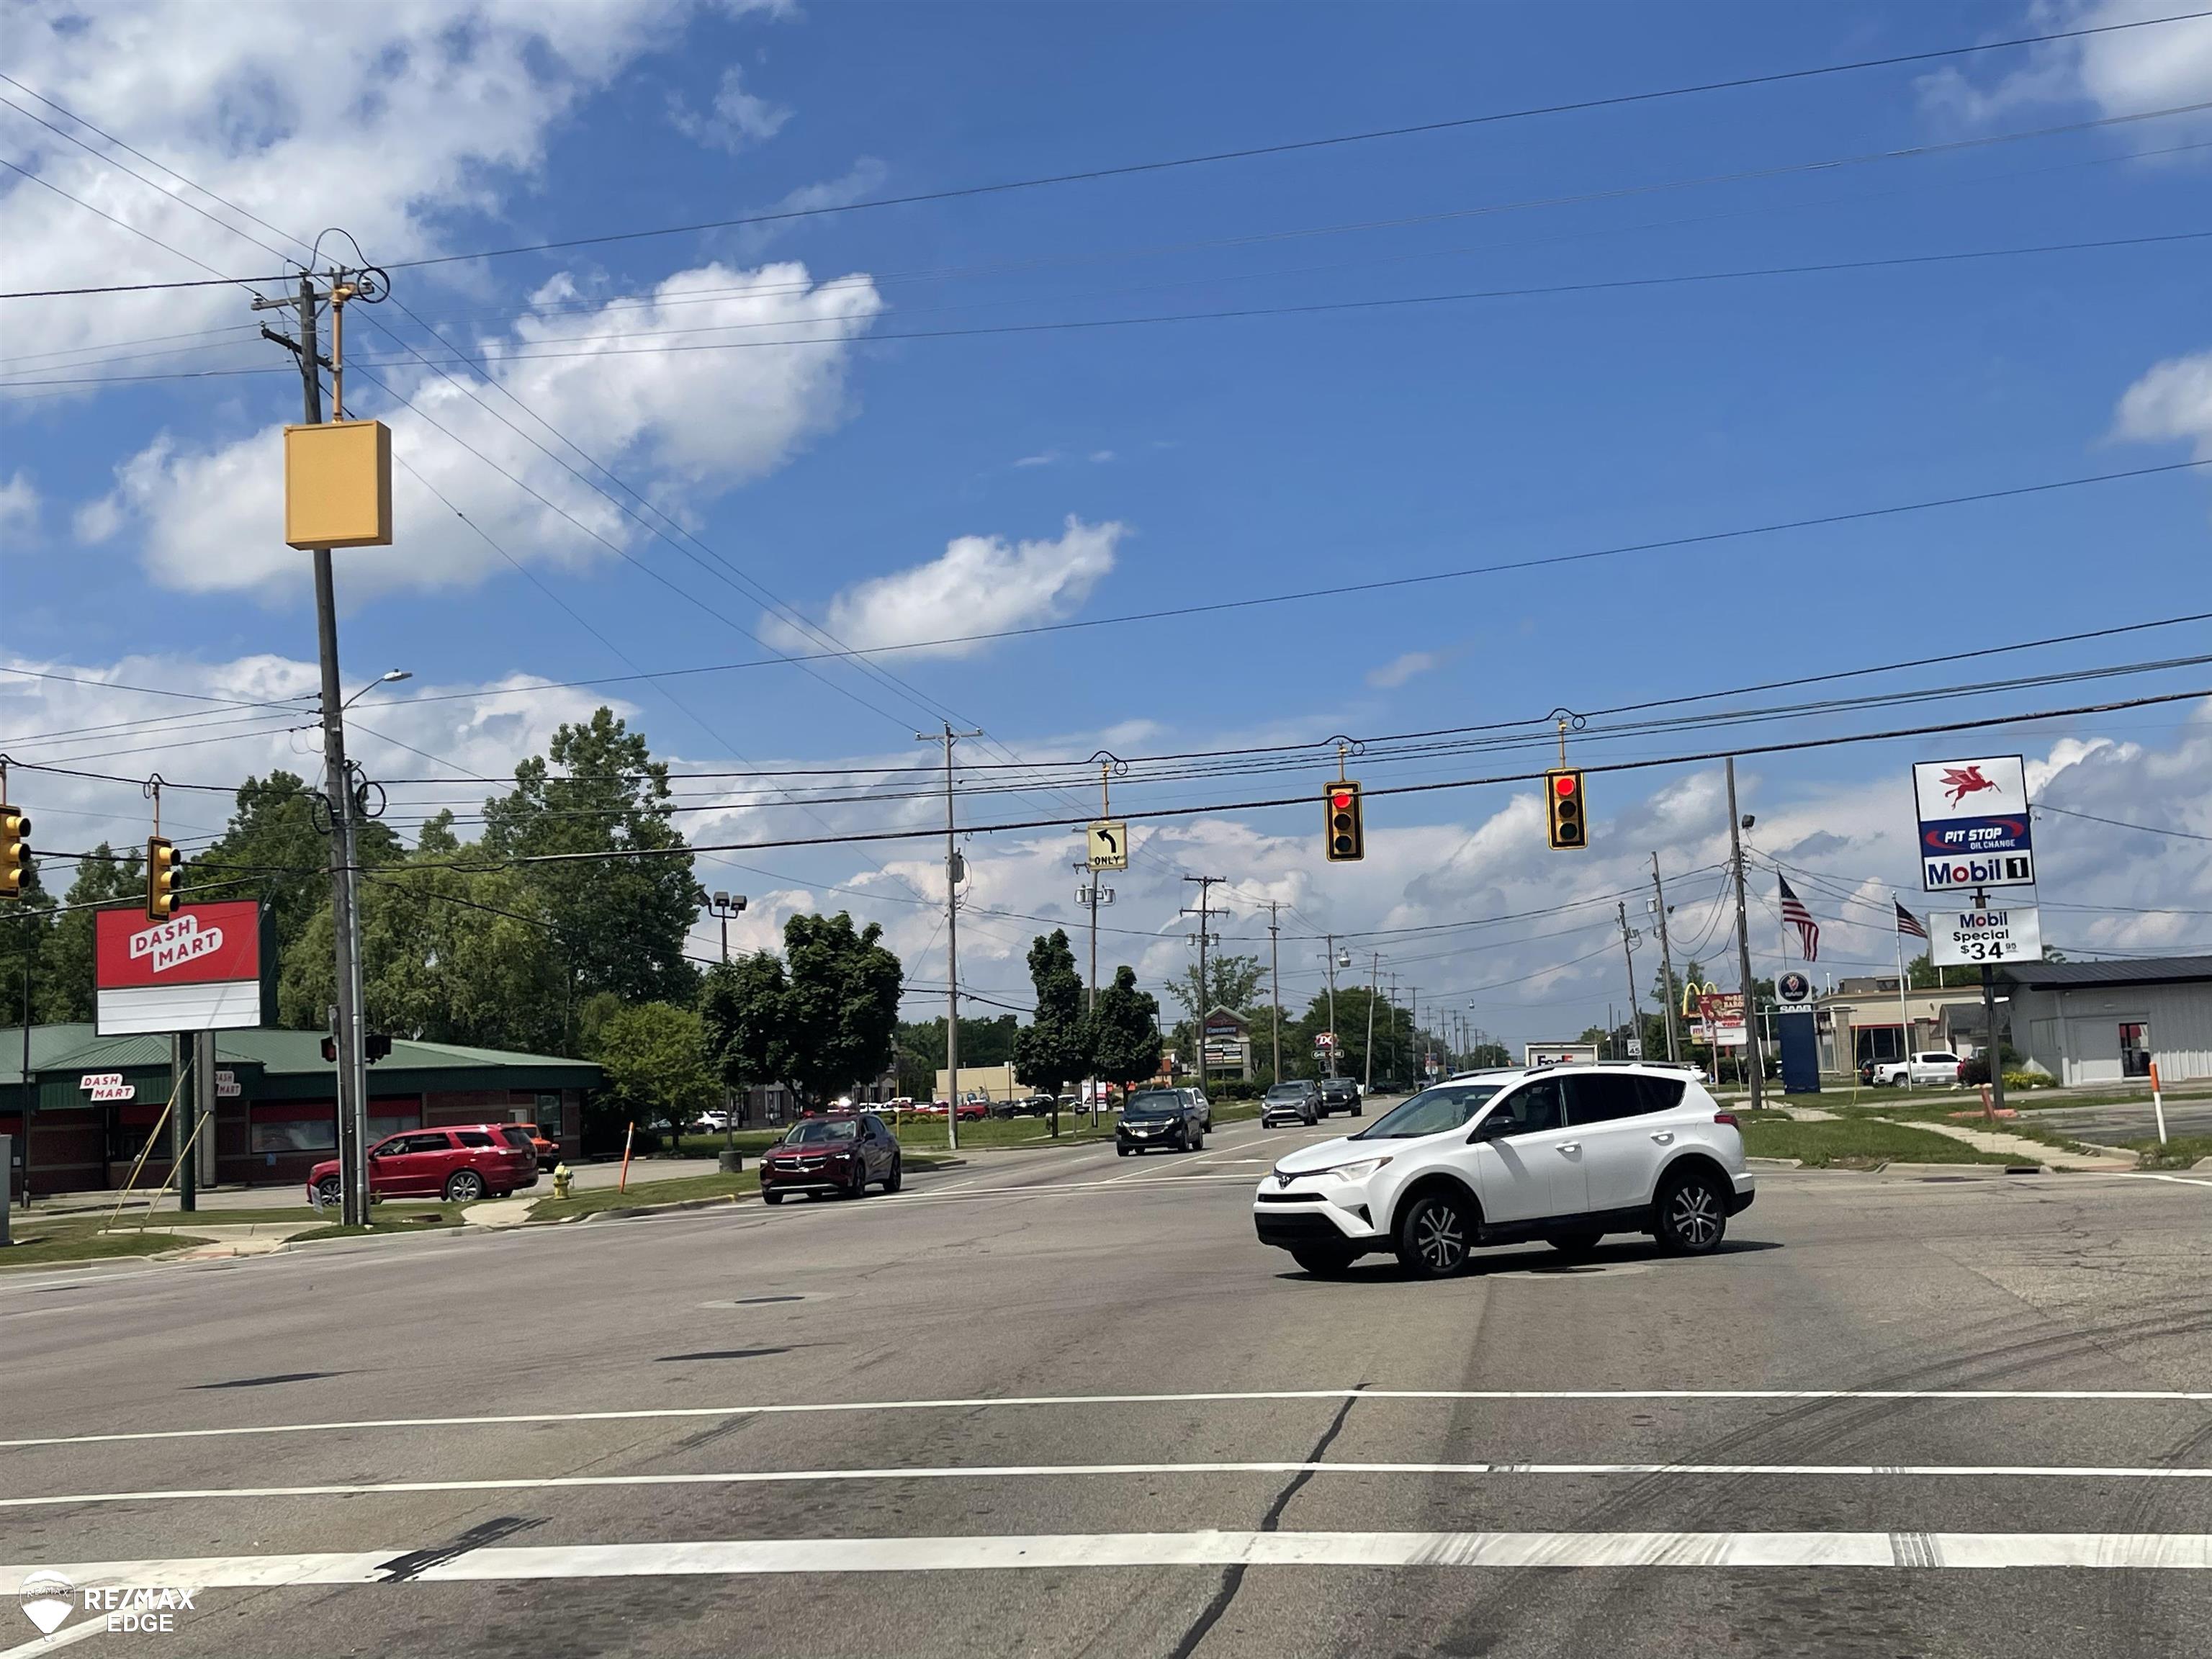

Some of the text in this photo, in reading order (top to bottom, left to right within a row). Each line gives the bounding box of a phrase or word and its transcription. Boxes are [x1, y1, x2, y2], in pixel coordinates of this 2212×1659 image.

[1944, 827, 2002, 843] PIT STOP
[1970, 839, 2015, 850] OIL CHANGE
[1094, 855, 1120, 866] ONLY
[1928, 858, 2023, 885] Mobil 1
[1959, 911, 2008, 928] Mobil
[135, 920, 190, 952] DASH
[1953, 929, 2010, 943] Special
[158, 932, 216, 966] MART
[1779, 1004, 1812, 1013] SAAB
[84, 1076, 119, 1087] DASH
[94, 1087, 132, 1099] MART
[219, 1084, 240, 1094] MART
